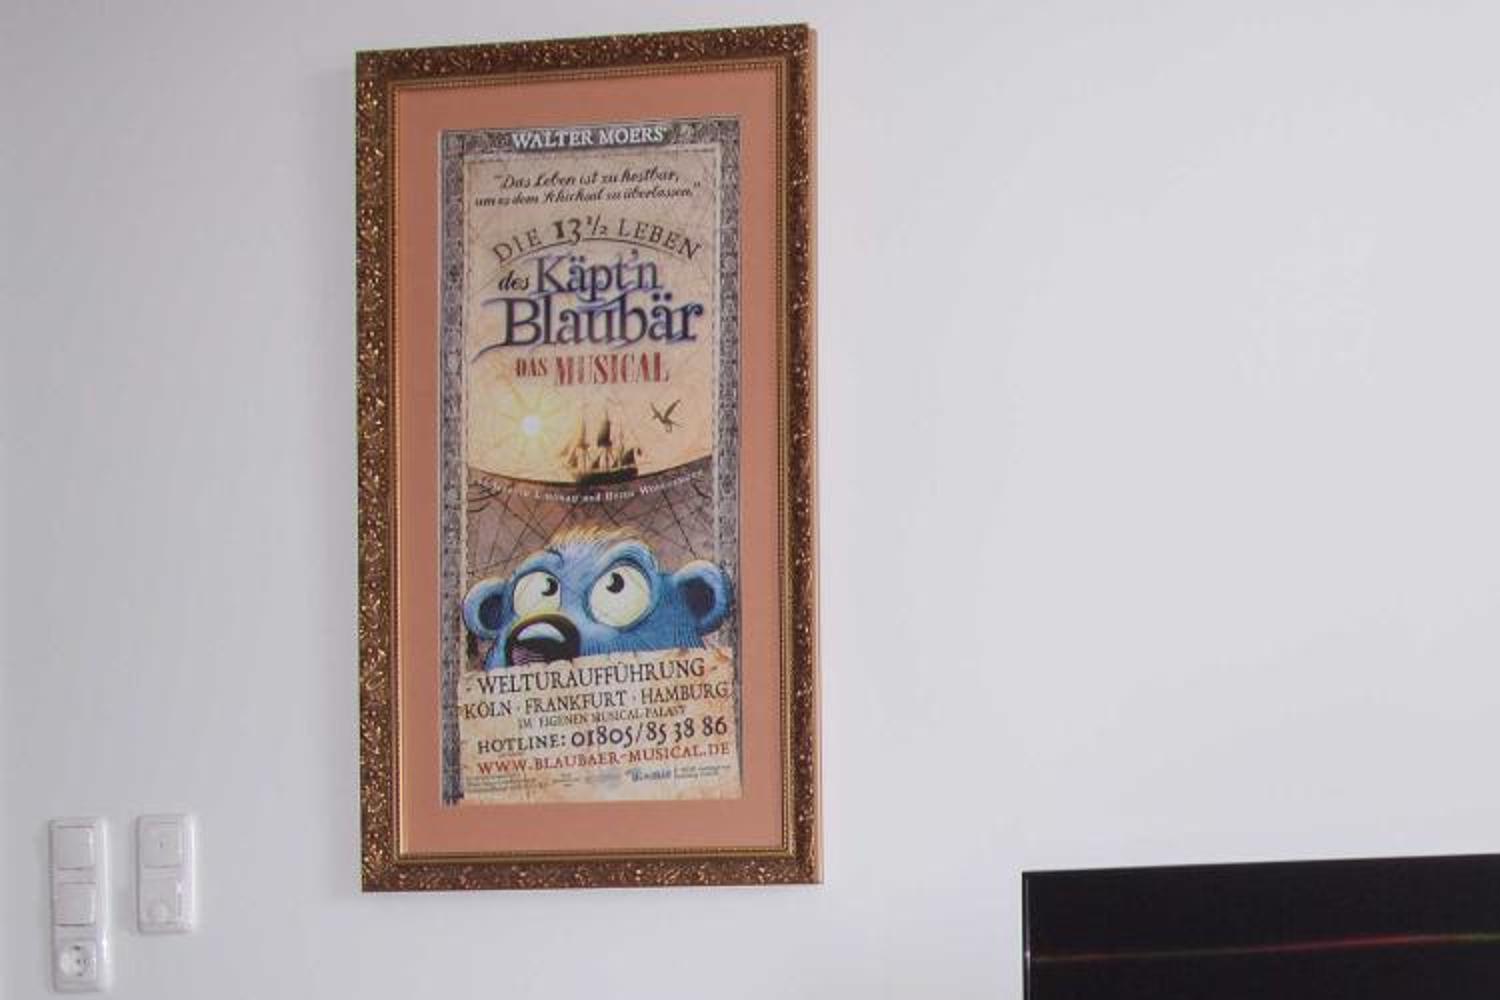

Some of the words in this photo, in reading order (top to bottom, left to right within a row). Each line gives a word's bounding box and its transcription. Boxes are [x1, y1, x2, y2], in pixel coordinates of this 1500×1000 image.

[512, 129, 594, 150] WALTER
[492, 228, 543, 262] DIE
[618, 216, 703, 261] LEBEN
[498, 271, 530, 292] des
[485, 292, 704, 352] Blaubär
[514, 357, 548, 378] DAS
[555, 351, 670, 386] MUSICAL
[477, 657, 706, 695] WELTURAUFFÜHRUNG
[524, 689, 628, 716] FRANKFURT
[476, 735, 566, 755] HOTLINE:
[673, 717, 695, 743] 38
[702, 715, 728, 737] 86
